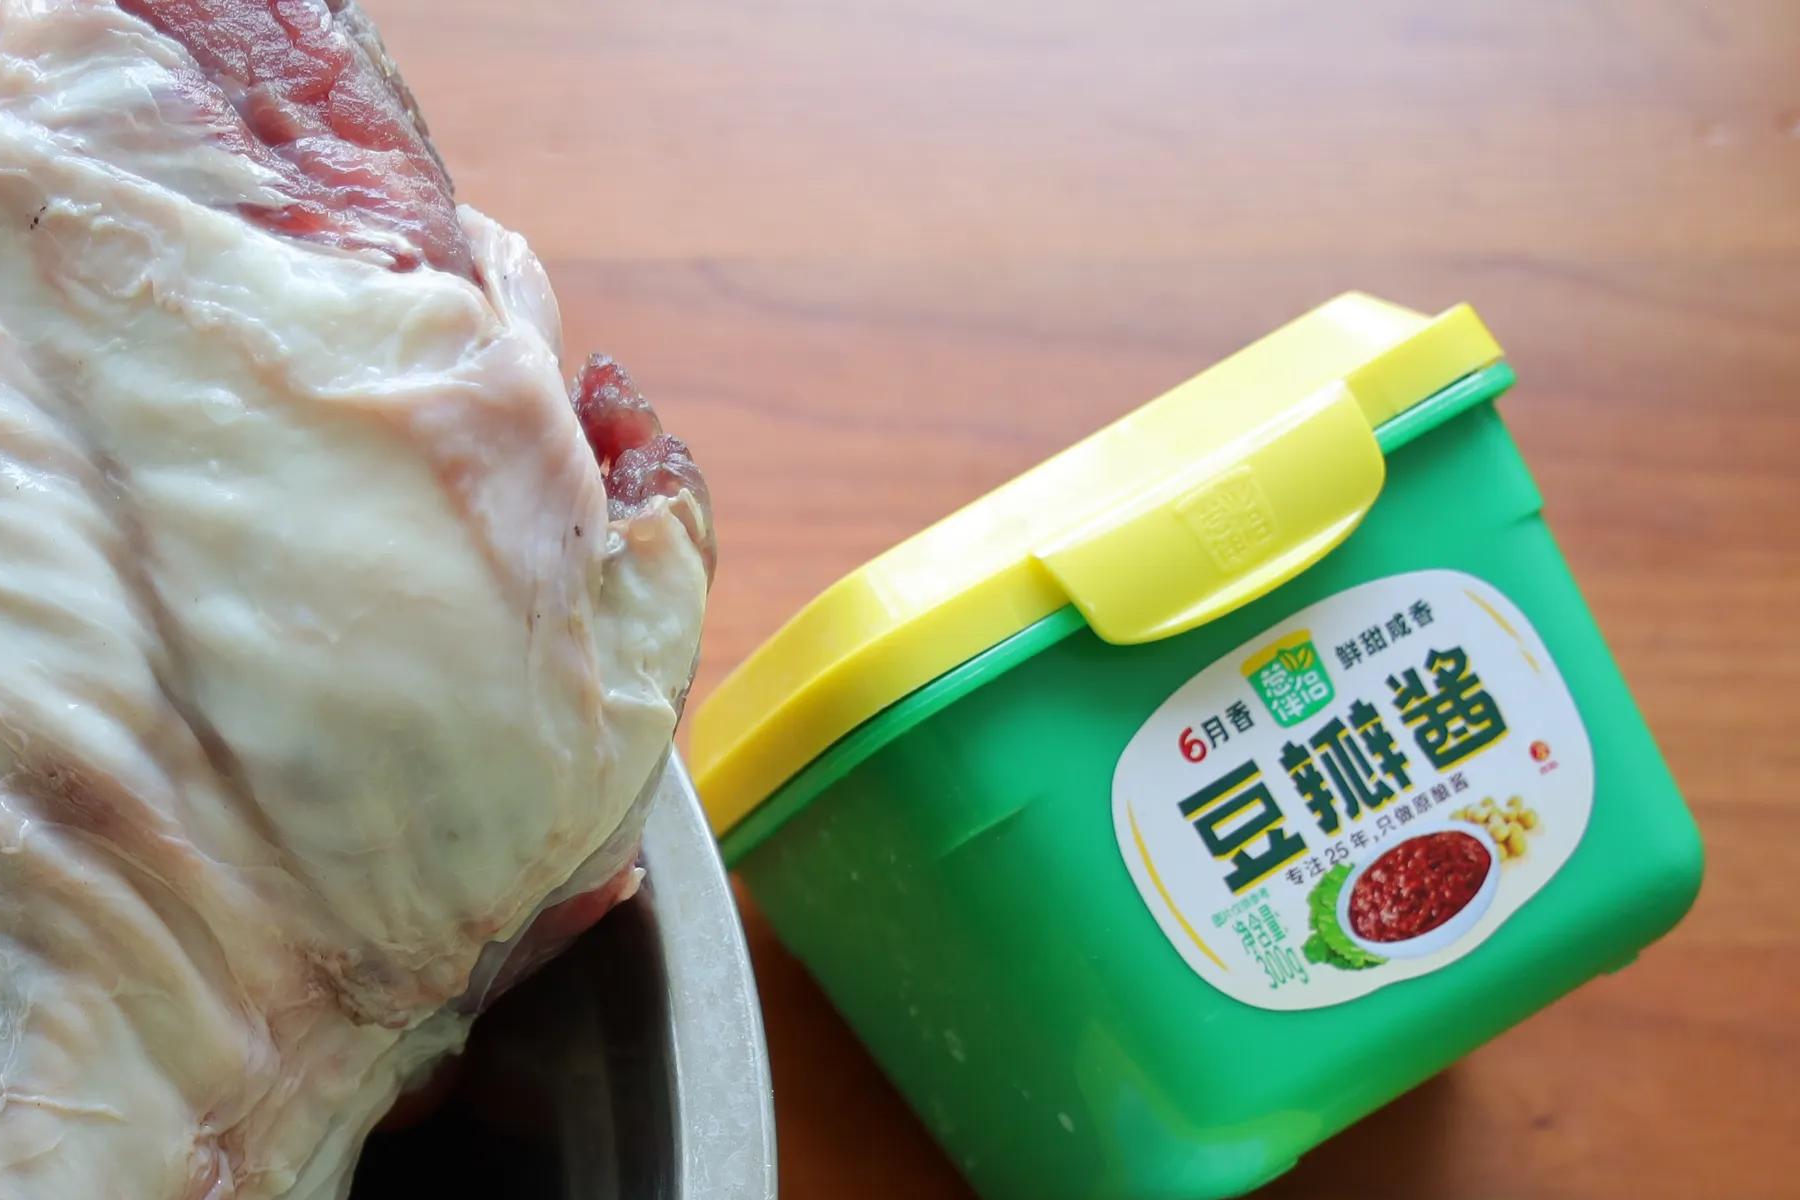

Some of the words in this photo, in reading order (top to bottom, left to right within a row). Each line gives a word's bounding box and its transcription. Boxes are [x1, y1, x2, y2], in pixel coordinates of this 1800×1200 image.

[1335, 600, 1434, 670] 鲜甜咸香
[1178, 700, 1255, 763] 6月香
[1177, 645, 1510, 897] 豆瓣酱
